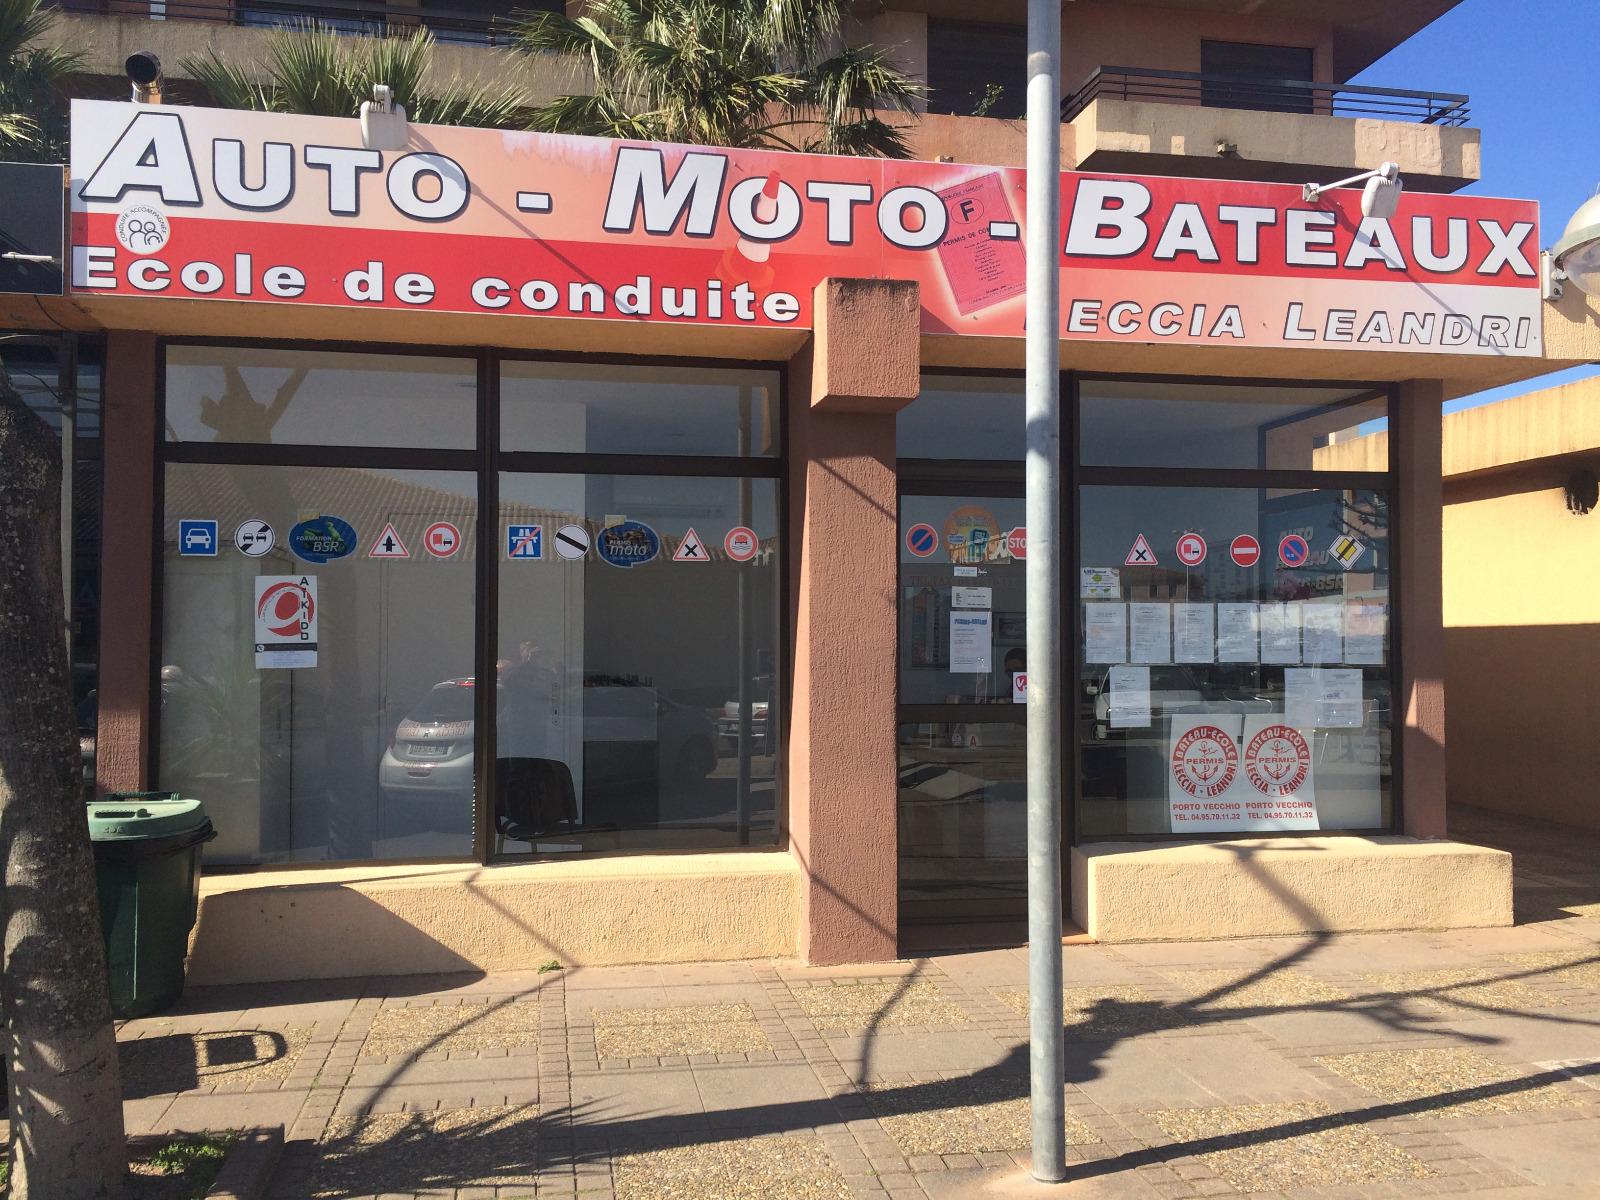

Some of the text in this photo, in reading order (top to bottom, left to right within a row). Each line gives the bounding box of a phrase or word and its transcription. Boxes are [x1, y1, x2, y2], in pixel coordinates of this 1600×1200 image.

[959, 199, 975, 222] F
[1064, 177, 1538, 278] BATEAUX
[71, 245, 801, 322] Ecole de conduite
[1024, 298, 1532, 349] ECCIA LEANDRI
[313, 540, 340, 552] BSR
[606, 544, 648, 556] moto
[1009, 537, 1027, 549] STO
[1173, 762, 1237, 797] LECCIA LEANDRI
[1246, 762, 1309, 796] LECCIA LEANDRI
[1173, 802, 1241, 811] PORTO VECCHIO
[1276, 801, 1313, 809] VECCHIO
[1174, 813, 1190, 821] TEL.
